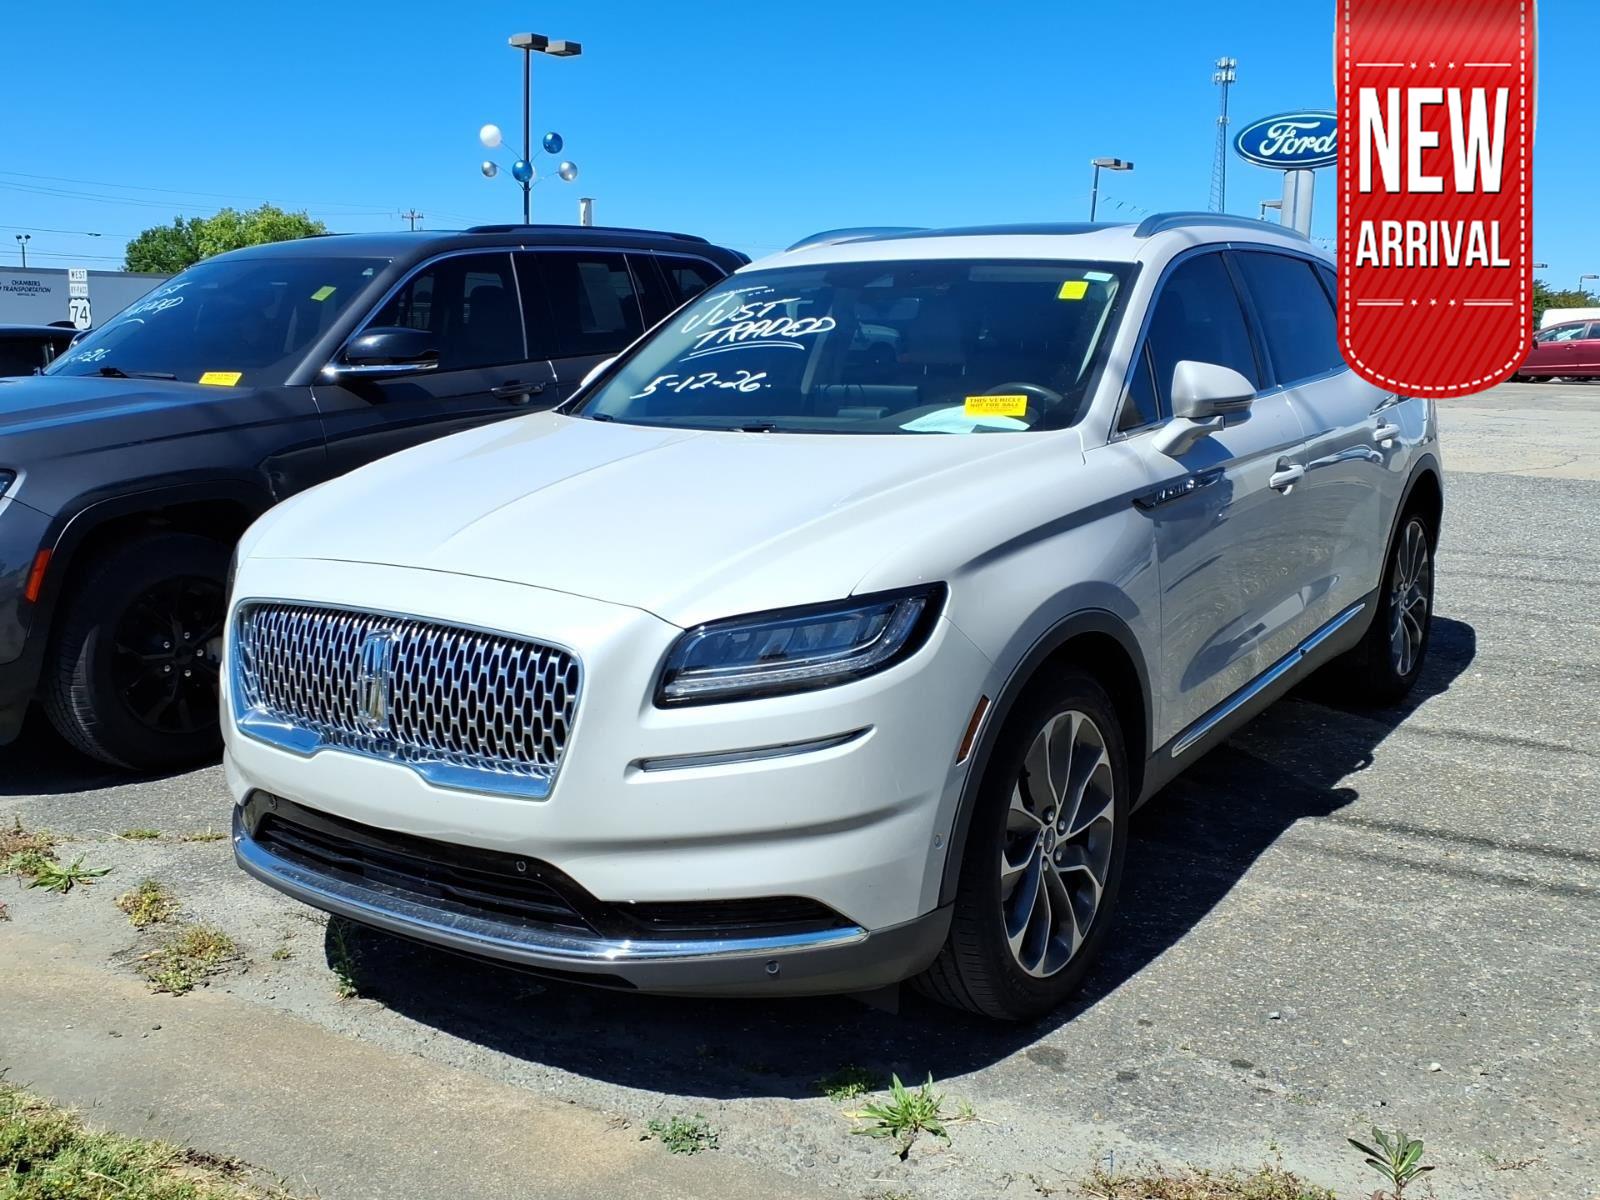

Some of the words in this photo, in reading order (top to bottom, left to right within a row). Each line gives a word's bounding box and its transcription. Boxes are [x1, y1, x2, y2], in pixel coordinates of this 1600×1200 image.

[1259, 121, 1338, 156] Ford
[71, 271, 86, 279] WEST
[71, 305, 89, 323] 74
[681, 286, 801, 333] JUST
[694, 316, 836, 349] TRADED
